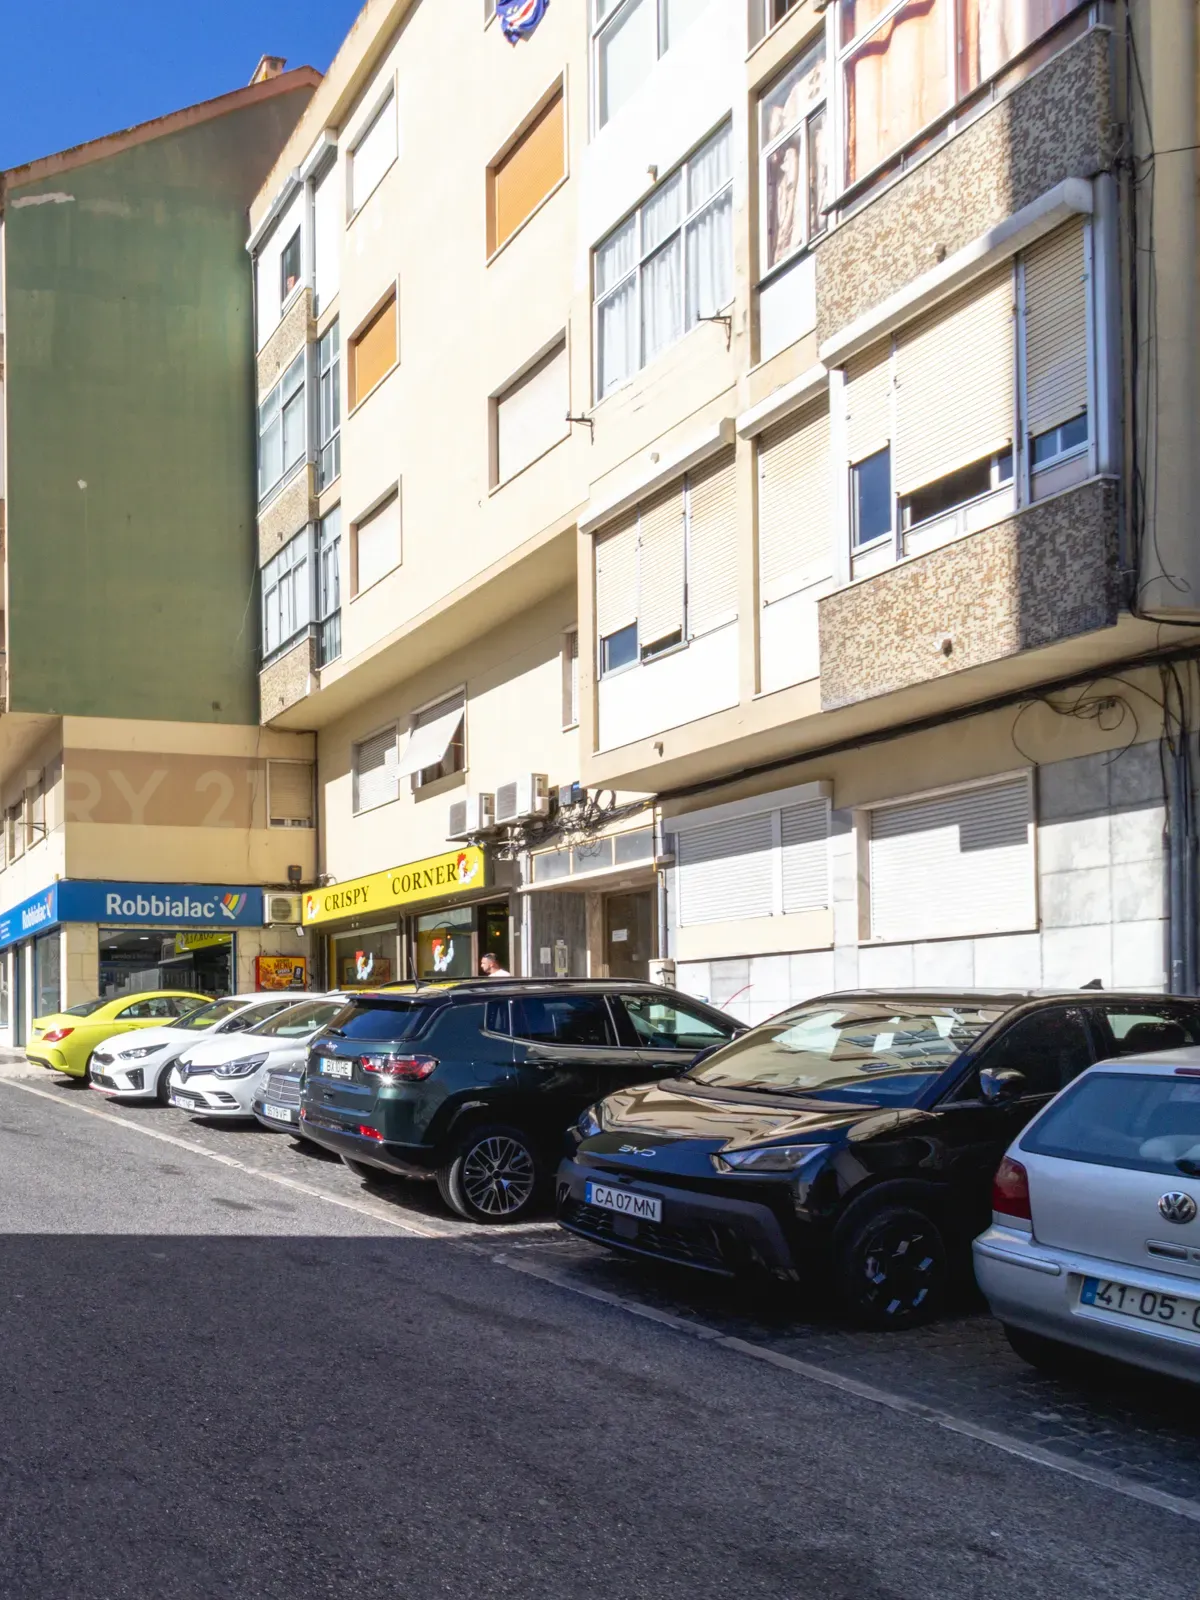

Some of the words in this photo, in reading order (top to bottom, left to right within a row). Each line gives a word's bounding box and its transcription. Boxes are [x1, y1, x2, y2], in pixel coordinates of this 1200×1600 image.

[324, 885, 370, 912] CRISPY
[392, 863, 458, 895] CORNER
[106, 893, 216, 918] Robbialac
[618, 1144, 657, 1157] BYD
